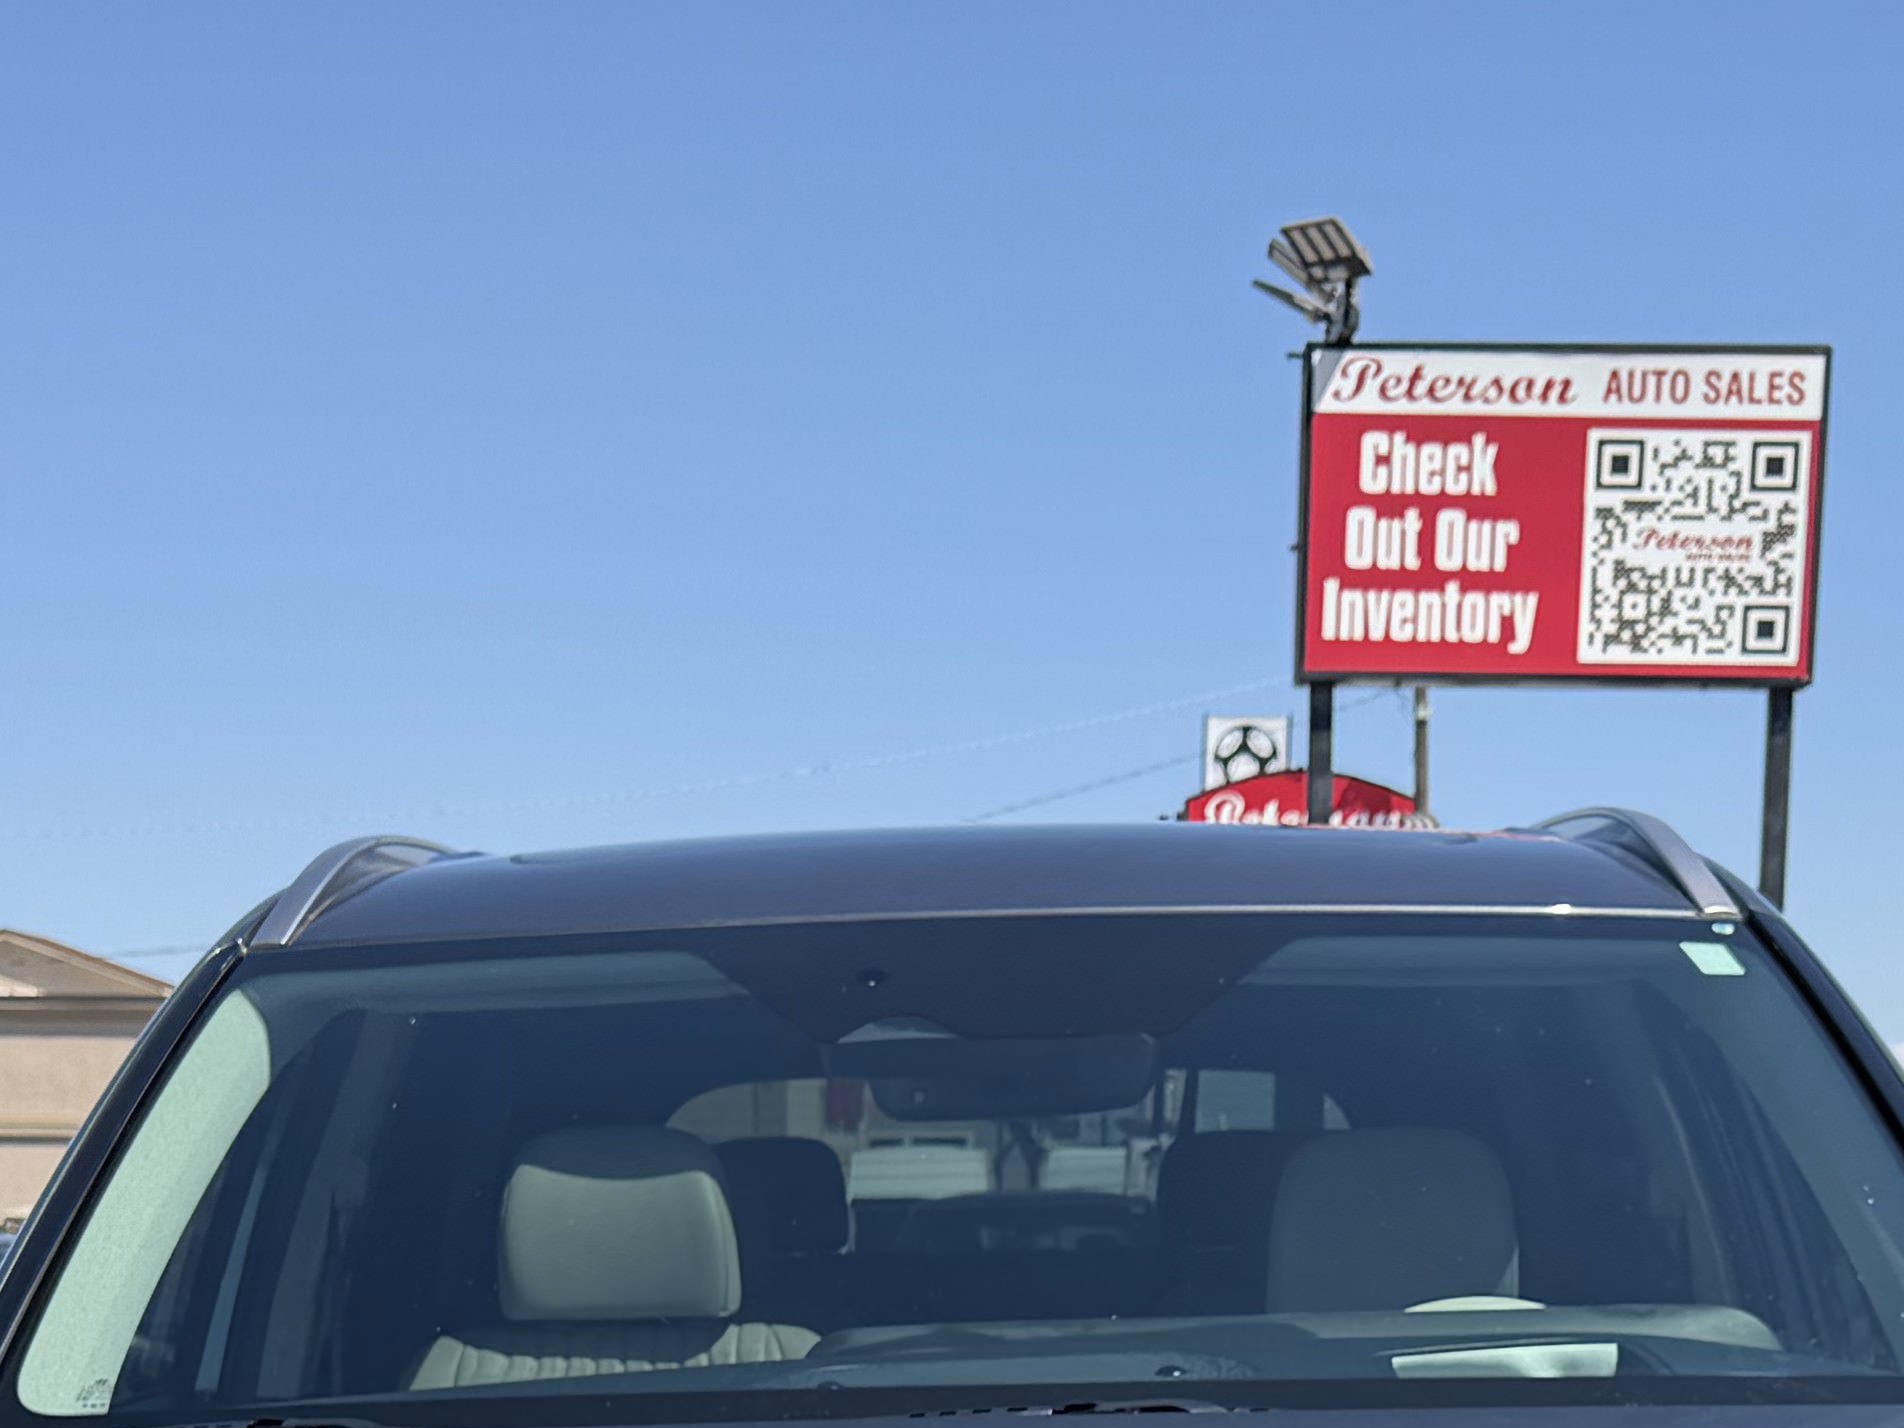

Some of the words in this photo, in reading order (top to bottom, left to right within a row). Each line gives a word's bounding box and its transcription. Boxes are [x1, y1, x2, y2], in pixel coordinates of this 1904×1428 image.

[1332, 355, 1578, 406] Peterson
[1603, 369, 1691, 405] AUTO
[1703, 371, 1806, 406] SALES
[1360, 430, 1499, 496] Check
[1344, 506, 1422, 571] Out
[1435, 507, 1520, 572] Our
[1321, 577, 1539, 655] Inventory
